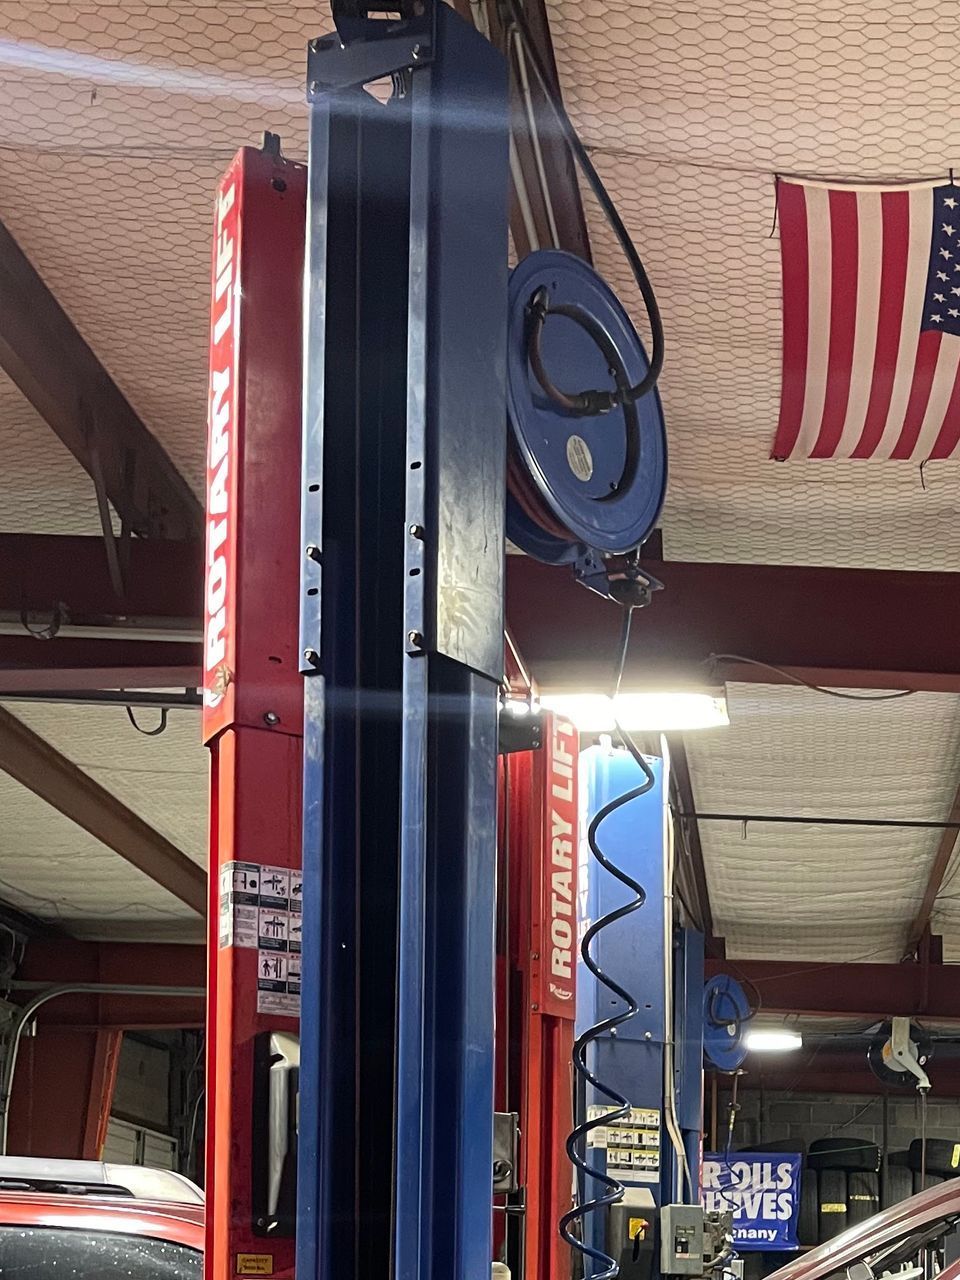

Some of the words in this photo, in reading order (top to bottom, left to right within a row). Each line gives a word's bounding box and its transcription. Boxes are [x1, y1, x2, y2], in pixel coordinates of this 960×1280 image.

[213, 183, 236, 345] LIFT
[206, 366, 230, 671] ROTARY
[552, 714, 573, 802] LIFT
[551, 810, 573, 979] ROTARY
[702, 1191, 793, 1220] ITIVES
[731, 1161, 793, 1190] OILS
